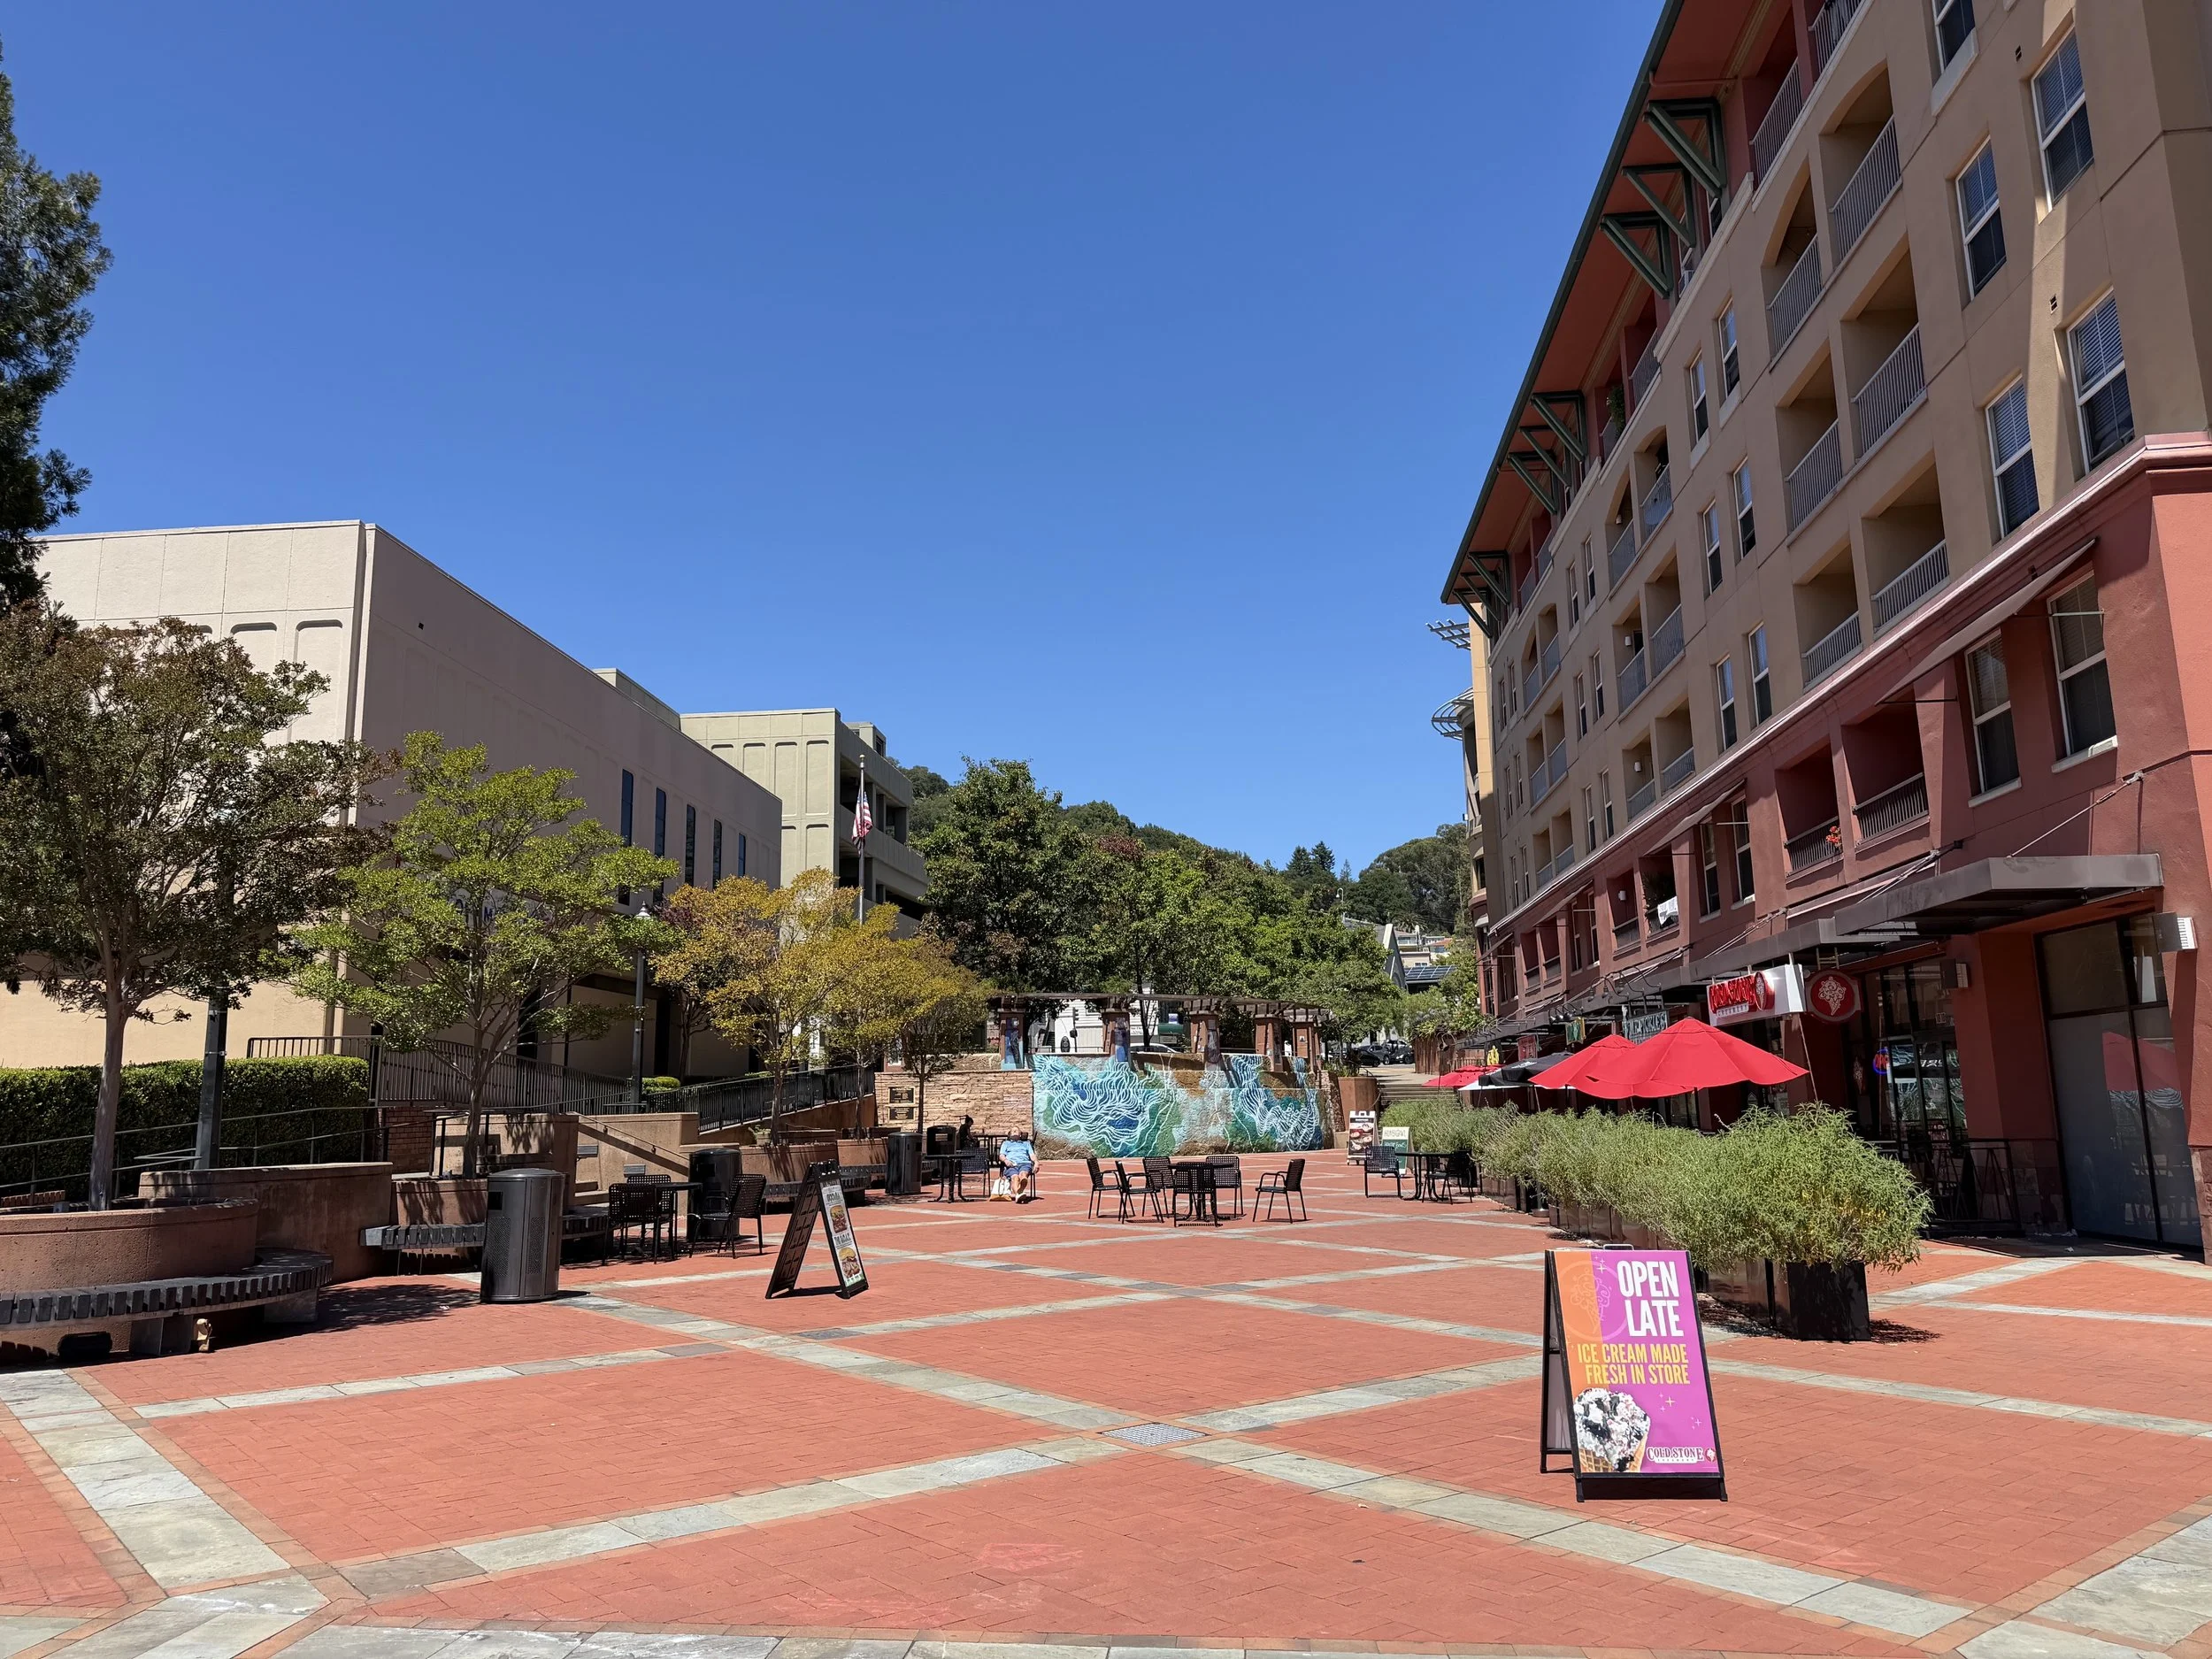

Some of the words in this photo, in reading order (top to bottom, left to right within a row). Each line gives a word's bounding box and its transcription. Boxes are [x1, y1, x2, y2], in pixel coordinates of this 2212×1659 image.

[1617, 1260, 1680, 1297] OPEN
[1624, 1300, 1684, 1336] LATE
[1578, 1343, 1599, 1363] ICE
[1601, 1343, 1648, 1363] CREAM
[1650, 1343, 1689, 1363] MADE
[1585, 1364, 1628, 1384] FRESH
[1631, 1364, 1646, 1384] IN
[1648, 1364, 1691, 1384] STORE
[1647, 1448, 1671, 1461] COLD
[1671, 1448, 1703, 1460] STONE
